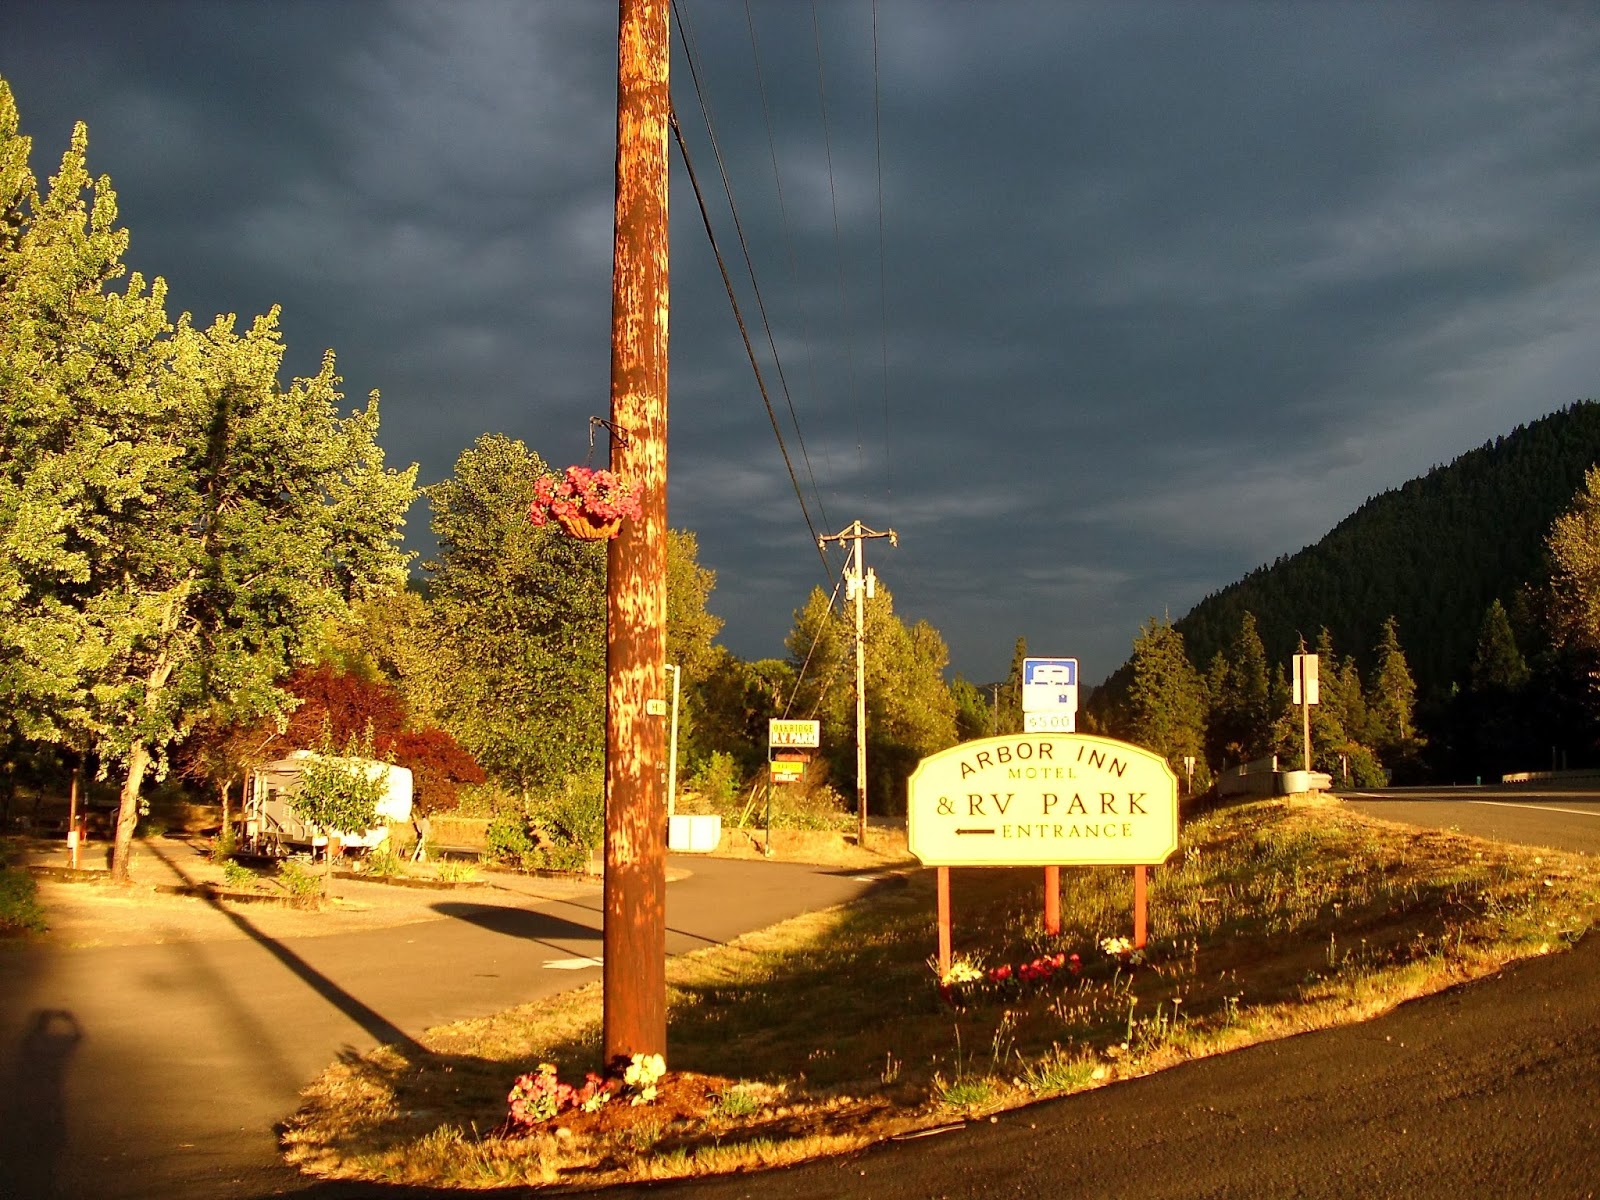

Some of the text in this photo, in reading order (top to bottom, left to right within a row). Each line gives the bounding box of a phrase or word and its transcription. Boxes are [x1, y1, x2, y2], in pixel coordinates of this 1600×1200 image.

[960, 742, 1127, 779] ARBOR INN
[1008, 767, 1077, 779] MOTEL
[936, 792, 1149, 815] & RV PARK
[1002, 823, 1134, 838] ENTRANCE
